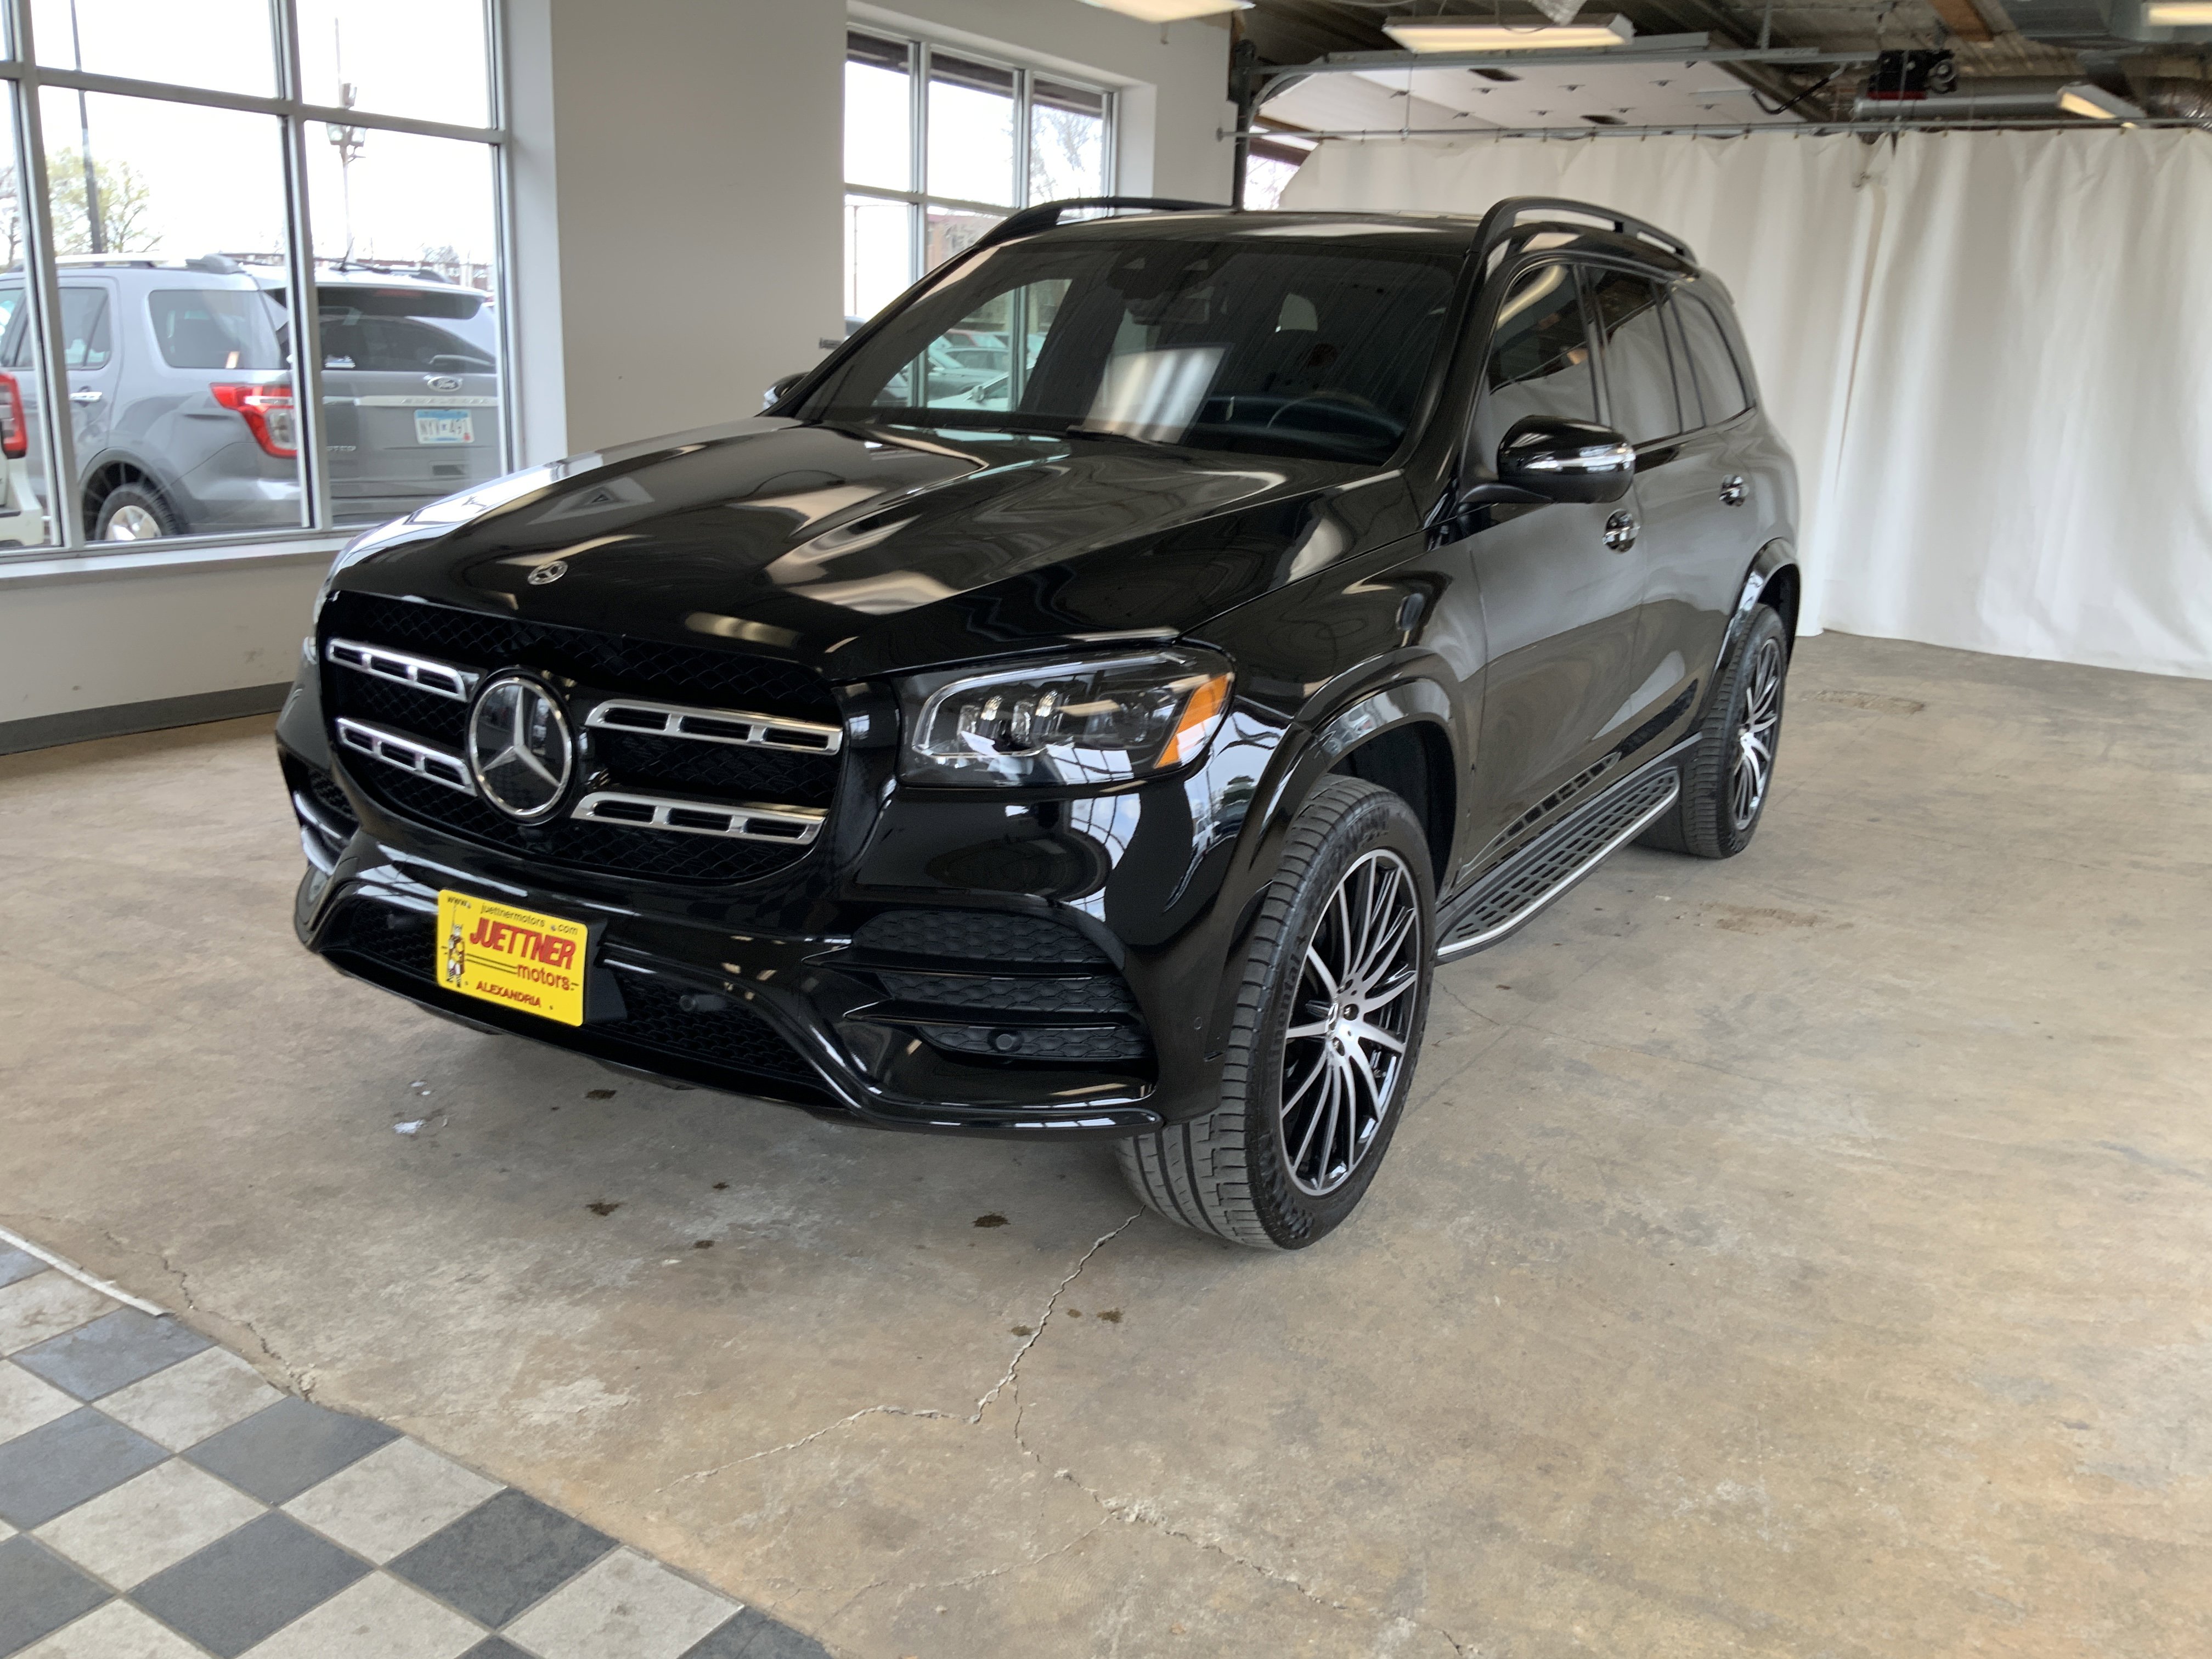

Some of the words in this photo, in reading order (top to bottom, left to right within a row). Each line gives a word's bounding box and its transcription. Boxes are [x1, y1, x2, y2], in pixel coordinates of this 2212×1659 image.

[481, 904, 545, 927] juettnermotors
[470, 917, 576, 970] JUETTNER
[518, 964, 569, 990] motors
[476, 981, 541, 1007] ALEXANDRIA
